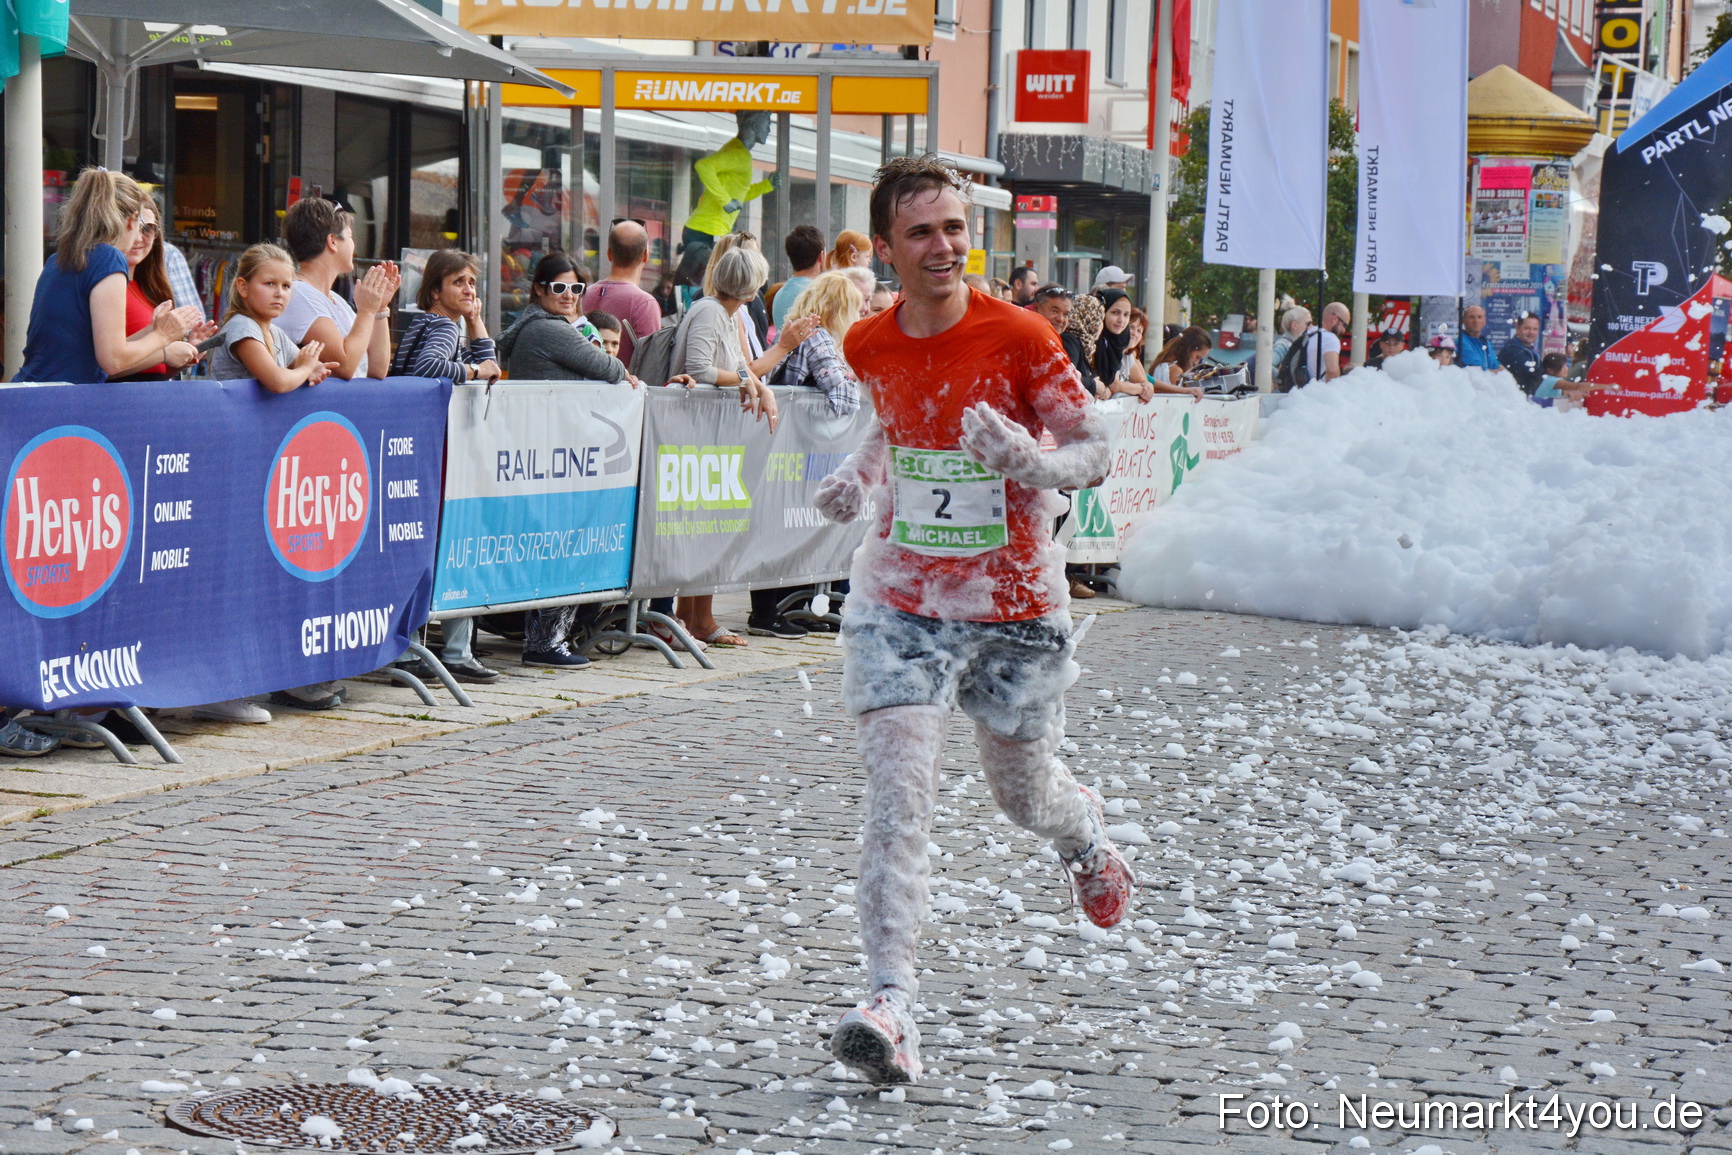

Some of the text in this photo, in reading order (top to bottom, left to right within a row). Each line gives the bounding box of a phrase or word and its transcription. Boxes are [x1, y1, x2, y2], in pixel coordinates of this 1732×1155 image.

[634, 79, 802, 104] RUNMARKT.DE
[1026, 74, 1076, 92] WITT
[1641, 119, 1710, 165] PARTL
[1477, 189, 1525, 198] BAND SUNRISE
[1482, 281, 1529, 290] Erntedankfest
[1608, 322, 1645, 331] 100 YEARS
[1619, 315, 1655, 323] THE NEXT
[1605, 352, 1632, 362] BMW
[388, 437, 413, 456] STORE
[155, 453, 190, 475] STORE
[497, 446, 601, 482] RAIL.ONE
[766, 453, 804, 482] OFFICE
[388, 479, 419, 499] ONLINE
[658, 453, 747, 503] BOCK
[276, 456, 363, 540] Hervis
[931, 488, 952, 520] 2
[154, 500, 192, 523] ONLINE
[15, 476, 121, 571] Hervis
[389, 521, 424, 542] MOBILE
[656, 516, 684, 538] inspired
[684, 516, 696, 539] by
[696, 518, 718, 534] smart
[287, 532, 323, 553] SPORTS
[446, 523, 627, 570] AUF JEDER STRECKE ZUHAUSE
[906, 527, 986, 545] MICHAEL
[151, 547, 190, 571] MOBILE
[26, 562, 71, 587] SPORTS
[441, 587, 468, 601] railone.de
[301, 615, 332, 657] GET
[39, 656, 76, 703] GET
